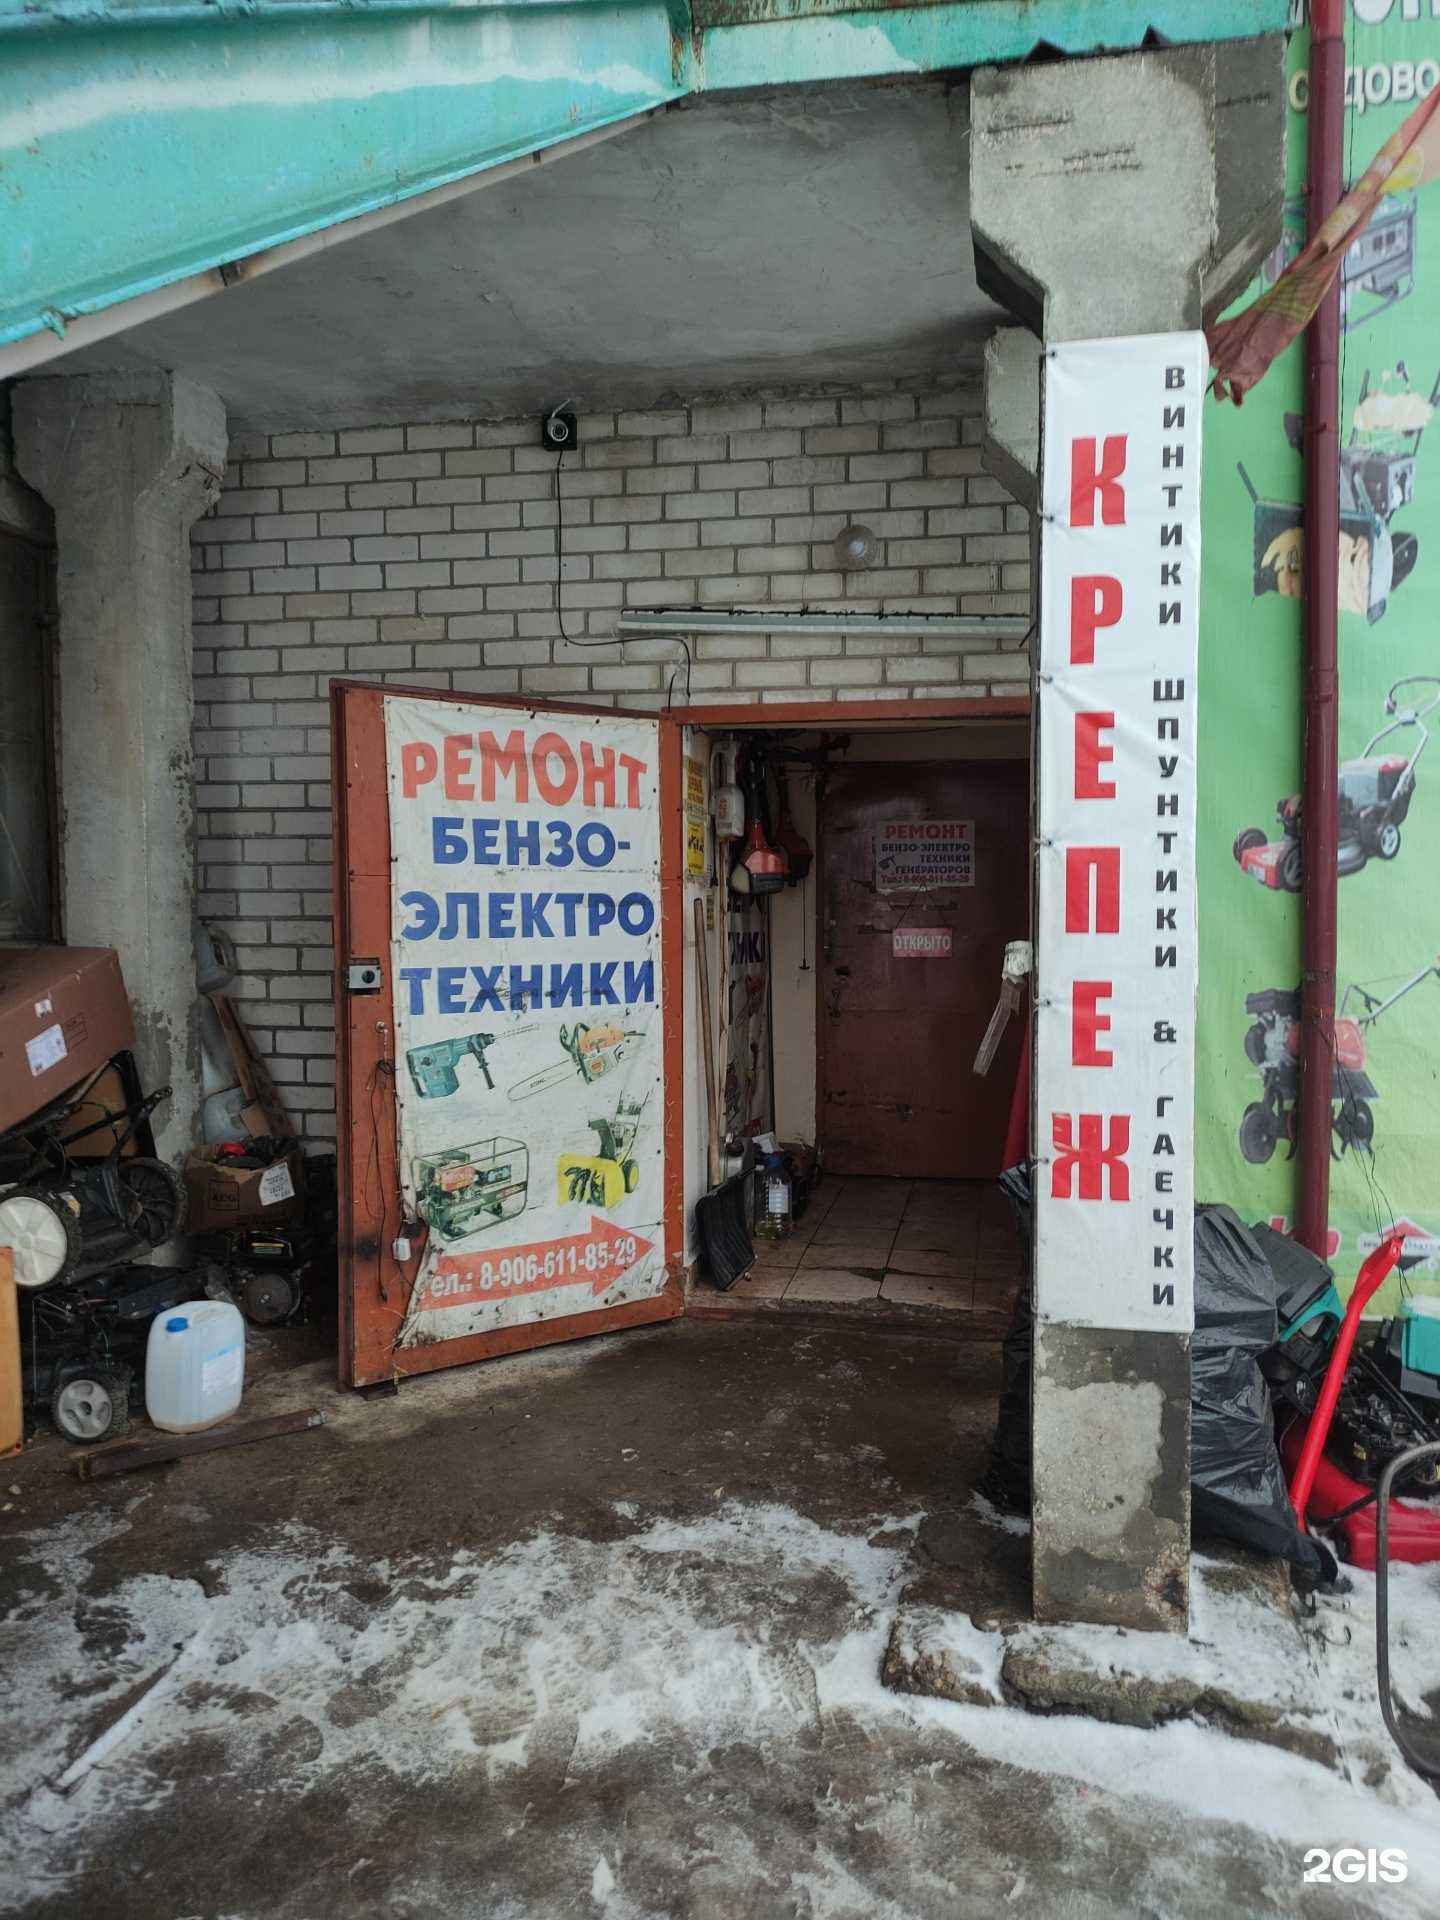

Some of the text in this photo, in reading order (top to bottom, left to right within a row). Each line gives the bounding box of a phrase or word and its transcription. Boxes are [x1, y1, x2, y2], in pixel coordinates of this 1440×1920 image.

[400, 729, 648, 810] РЕМОНТ
[431, 816, 631, 868] БЕНЗО-
[885, 824, 967, 840] РЕМОНТ
[1051, 432, 1131, 1203] КРЕПЕЖ
[1152, 365, 1187, 1307] ВИНТИКИ ШПУНТИКИ & ГАЕЧКИ
[894, 864, 971, 875] ГЕНЕРАТОРОВ
[919, 854, 971, 864] ТЕХНИКИ
[399, 890, 656, 942] ЭЛЕКТРО
[894, 935, 952, 951] ОТКРЫТО
[399, 959, 656, 1017] ТЕХНИКИ
[479, 1235, 638, 1292] 8-906-611-85-29
